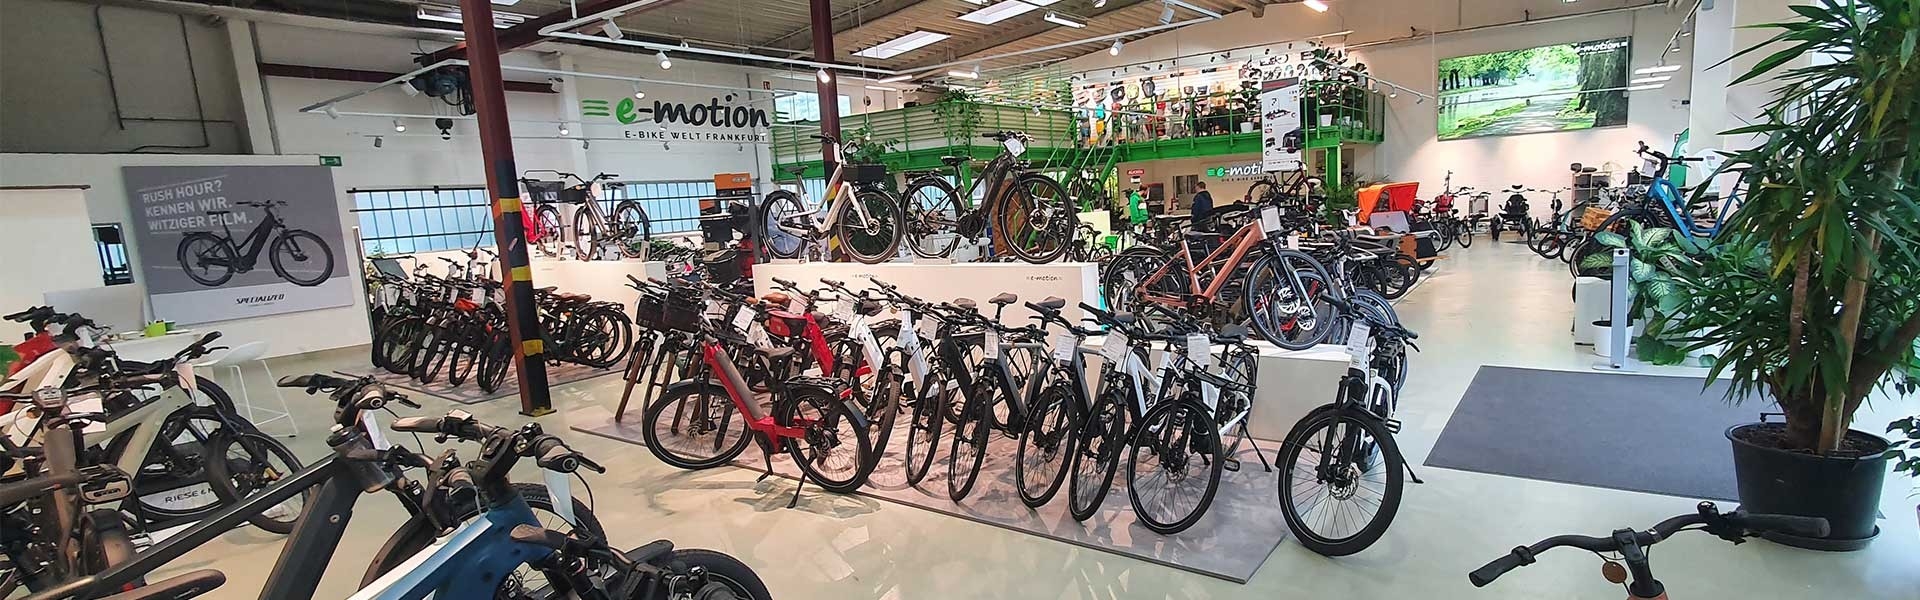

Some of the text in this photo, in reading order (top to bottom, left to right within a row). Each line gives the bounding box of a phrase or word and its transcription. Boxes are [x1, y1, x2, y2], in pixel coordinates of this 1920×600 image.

[616, 94, 770, 128] e-motion
[624, 130, 767, 143] E-BIKE WELT FRANKFURT
[1216, 161, 1264, 177] e-moti
[142, 180, 222, 204] RUSH HOUR?
[145, 196, 233, 217] KENNEN WIR.
[147, 211, 253, 231] WITZIGER FILM.
[165, 490, 199, 503] RIESE
